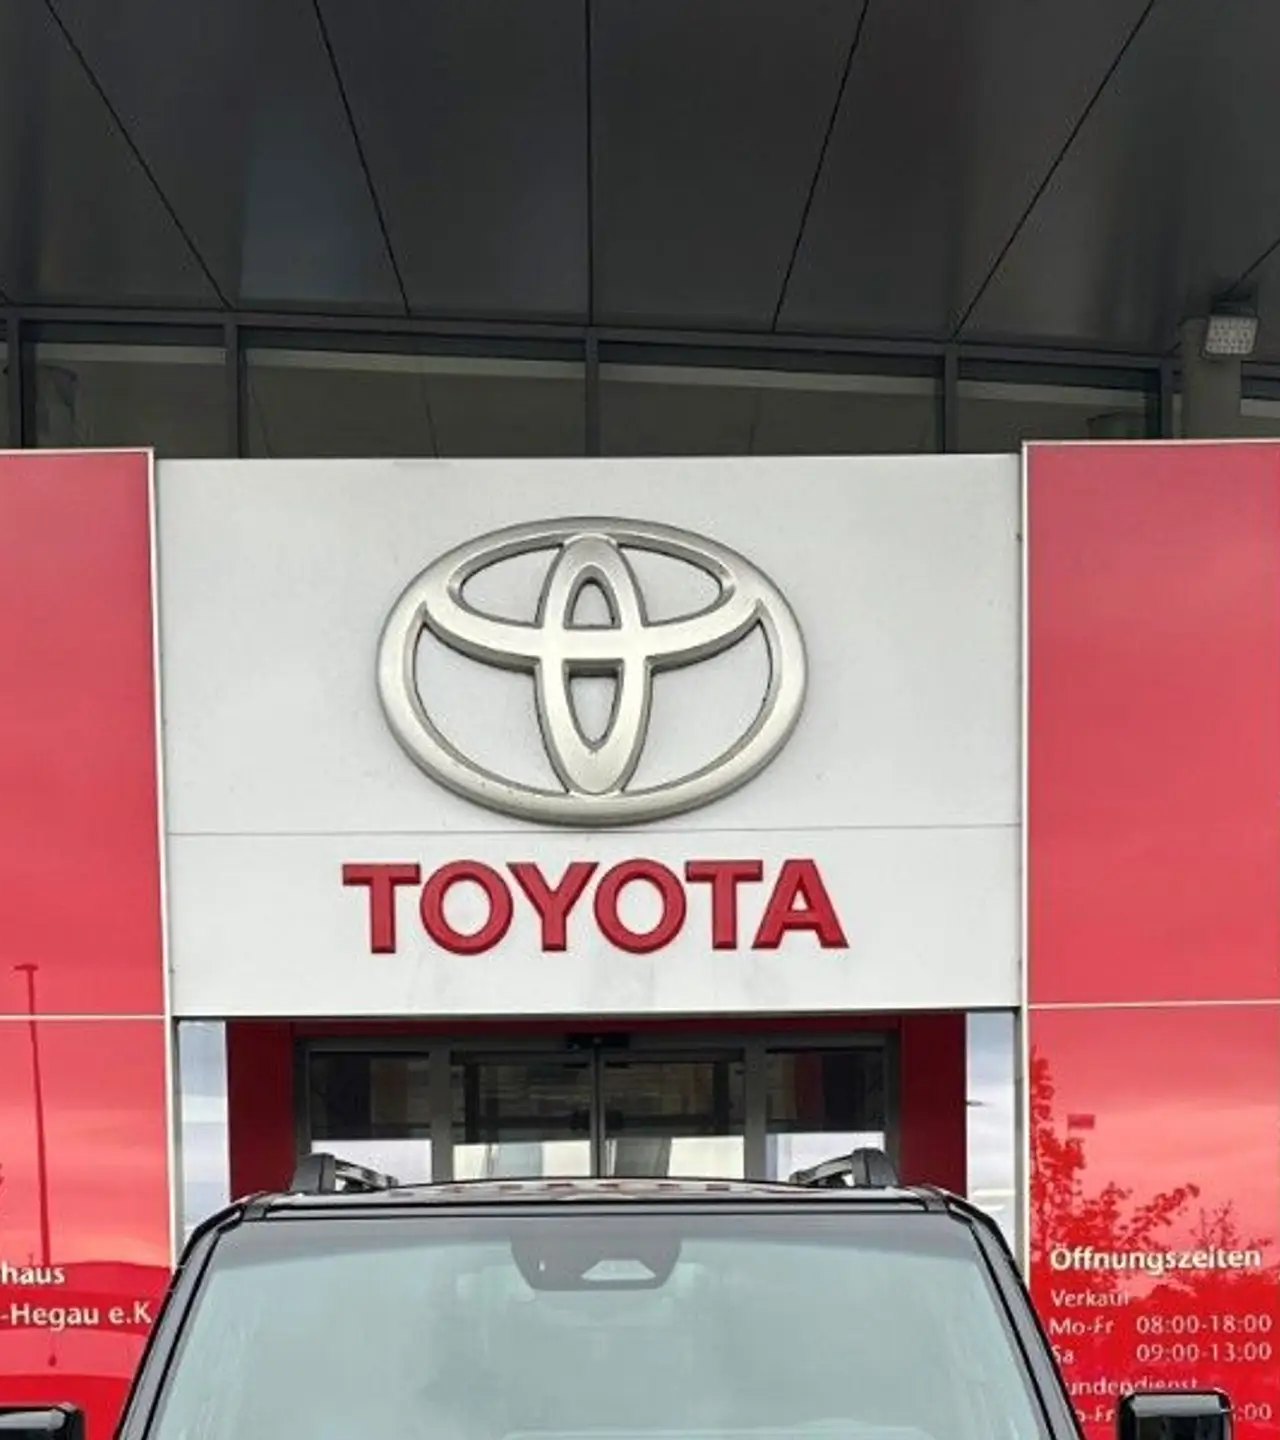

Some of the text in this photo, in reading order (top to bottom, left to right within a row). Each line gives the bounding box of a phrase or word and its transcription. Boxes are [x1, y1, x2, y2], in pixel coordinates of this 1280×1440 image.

[343, 859, 849, 956] TOYOTA
[1050, 1243, 1262, 1275] Öffnungszeiten
[1049, 1314, 1272, 1335] Mo-Fr 08:00-18:00
[1136, 1343, 1272, 1362] 09:00-13:00
[1065, 1376, 1198, 1396] undendienst
